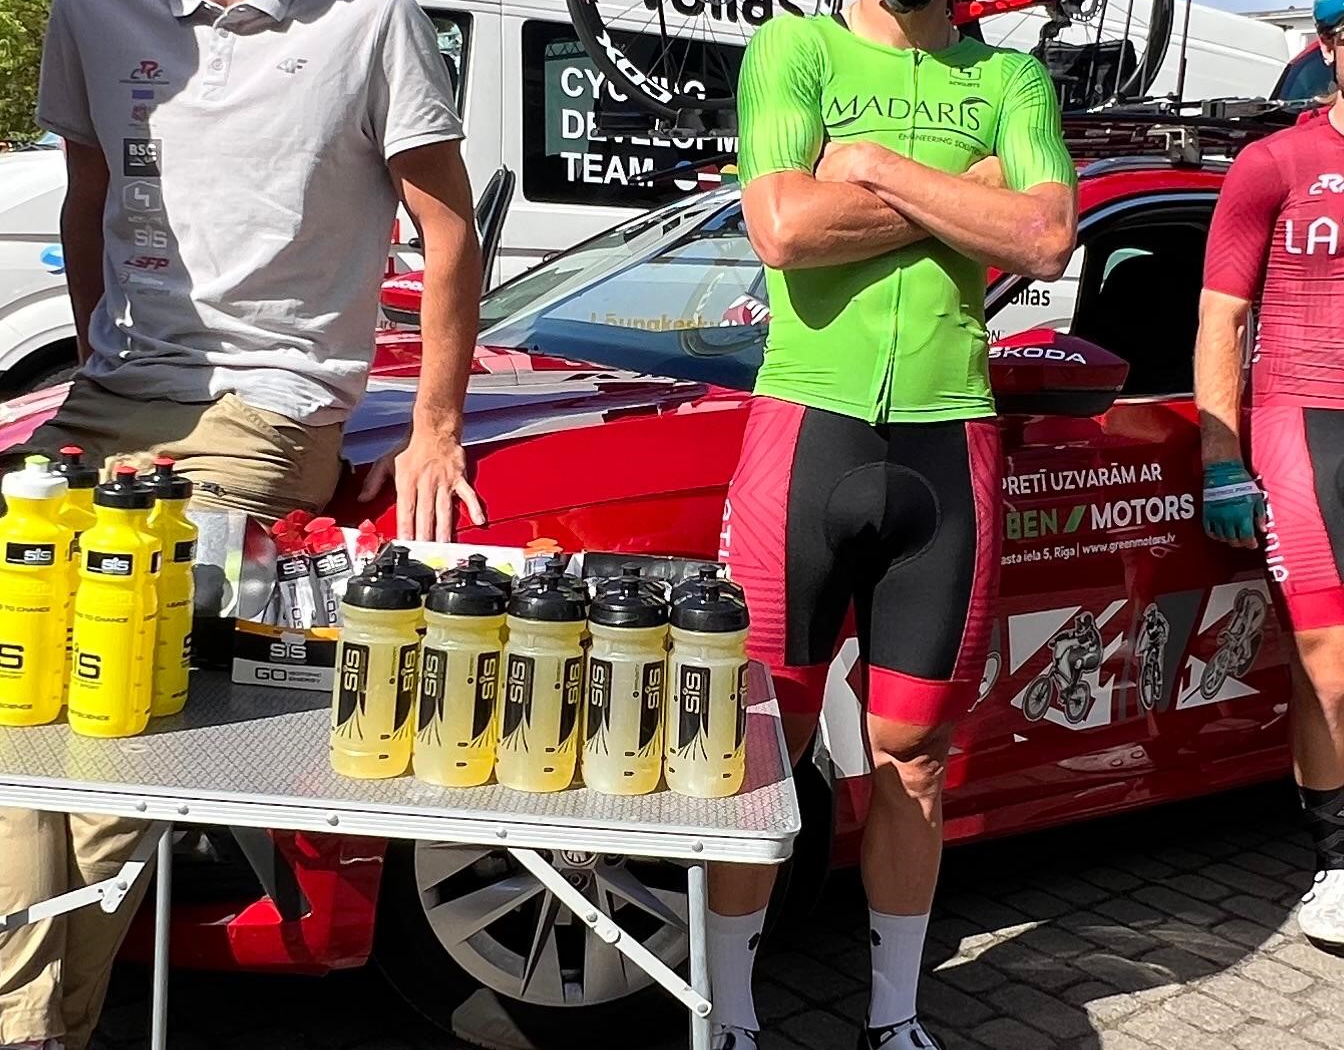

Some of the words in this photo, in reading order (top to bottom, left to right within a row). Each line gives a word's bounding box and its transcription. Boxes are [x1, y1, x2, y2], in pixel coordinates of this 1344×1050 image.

[825, 95, 984, 132] MADARIS
[898, 133, 953, 146] ENINEERING
[559, 151, 655, 188] TEAM
[1050, 462, 1137, 492] UZVARĀM
[1139, 463, 1164, 482] AR
[1090, 493, 1196, 530] MOTORS
[1001, 555, 1022, 565] asta
[255, 667, 287, 681] GO
